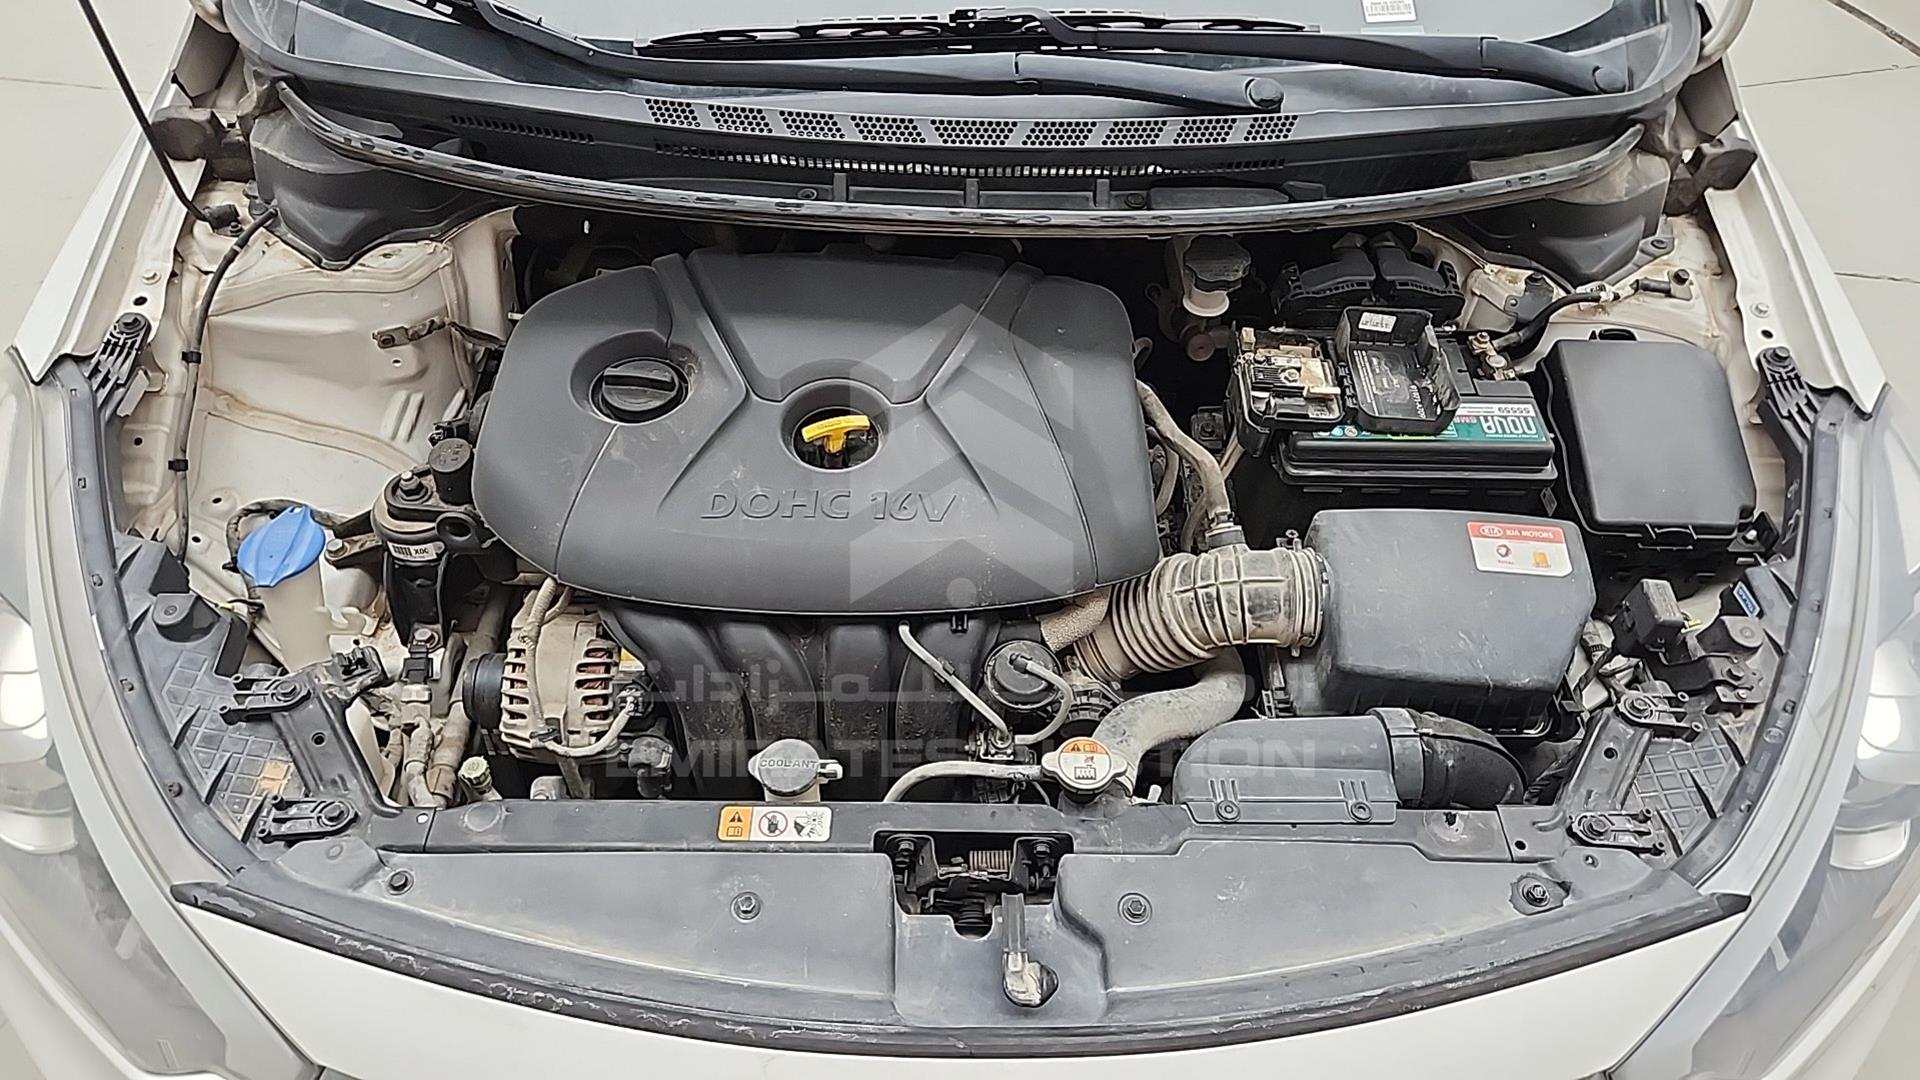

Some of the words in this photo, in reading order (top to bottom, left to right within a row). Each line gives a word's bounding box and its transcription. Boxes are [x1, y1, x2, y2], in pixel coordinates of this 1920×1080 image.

[1480, 416, 1537, 434] NOVA
[701, 489, 852, 520] DOHC
[870, 490, 957, 522] 16V
[1482, 527, 1500, 535] KIA
[1506, 529, 1520, 537] KIA
[1521, 530, 1554, 539] MOTORS
[760, 759, 818, 769] COOLANT
